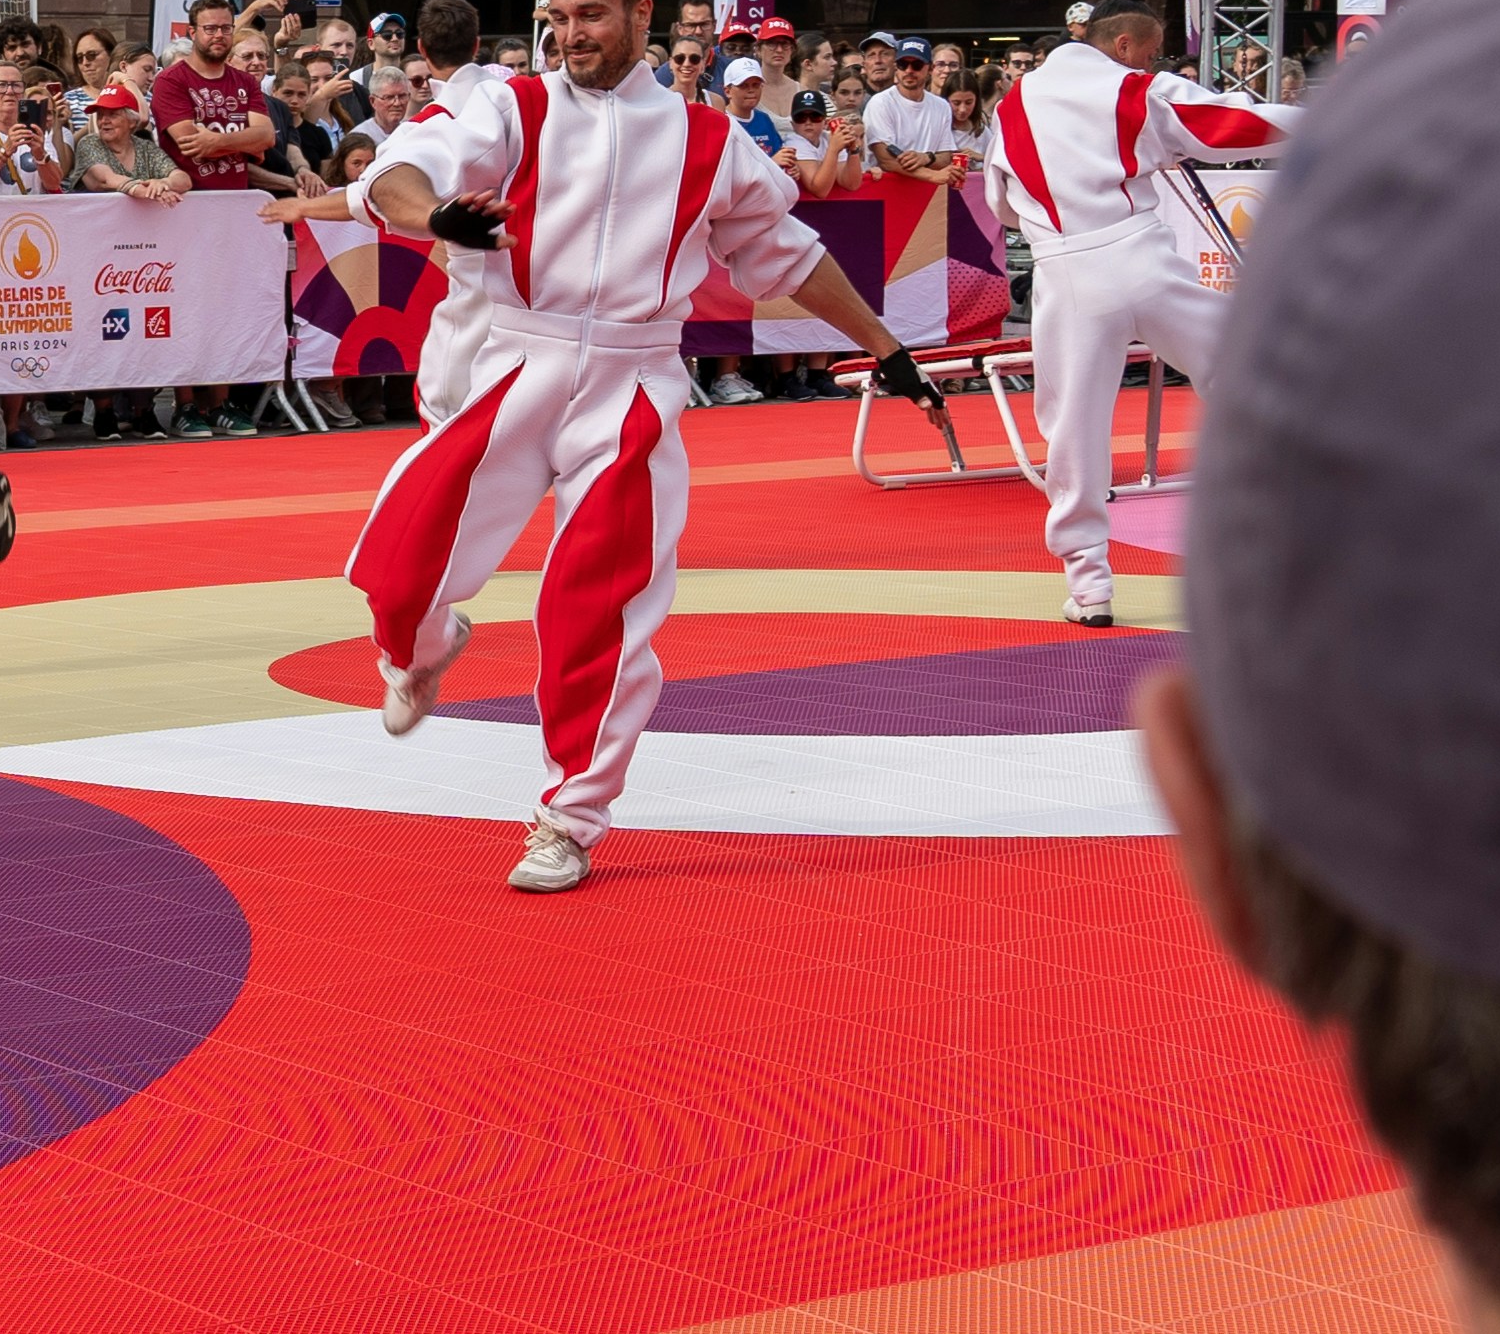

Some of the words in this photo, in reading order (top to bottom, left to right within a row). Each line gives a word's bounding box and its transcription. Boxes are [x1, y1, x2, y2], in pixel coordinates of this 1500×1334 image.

[113, 242, 143, 251] PARRAINÉ
[47, 285, 66, 301] DE
[8, 301, 73, 318] FLAMME
[34, 339, 67, 350] 2024
